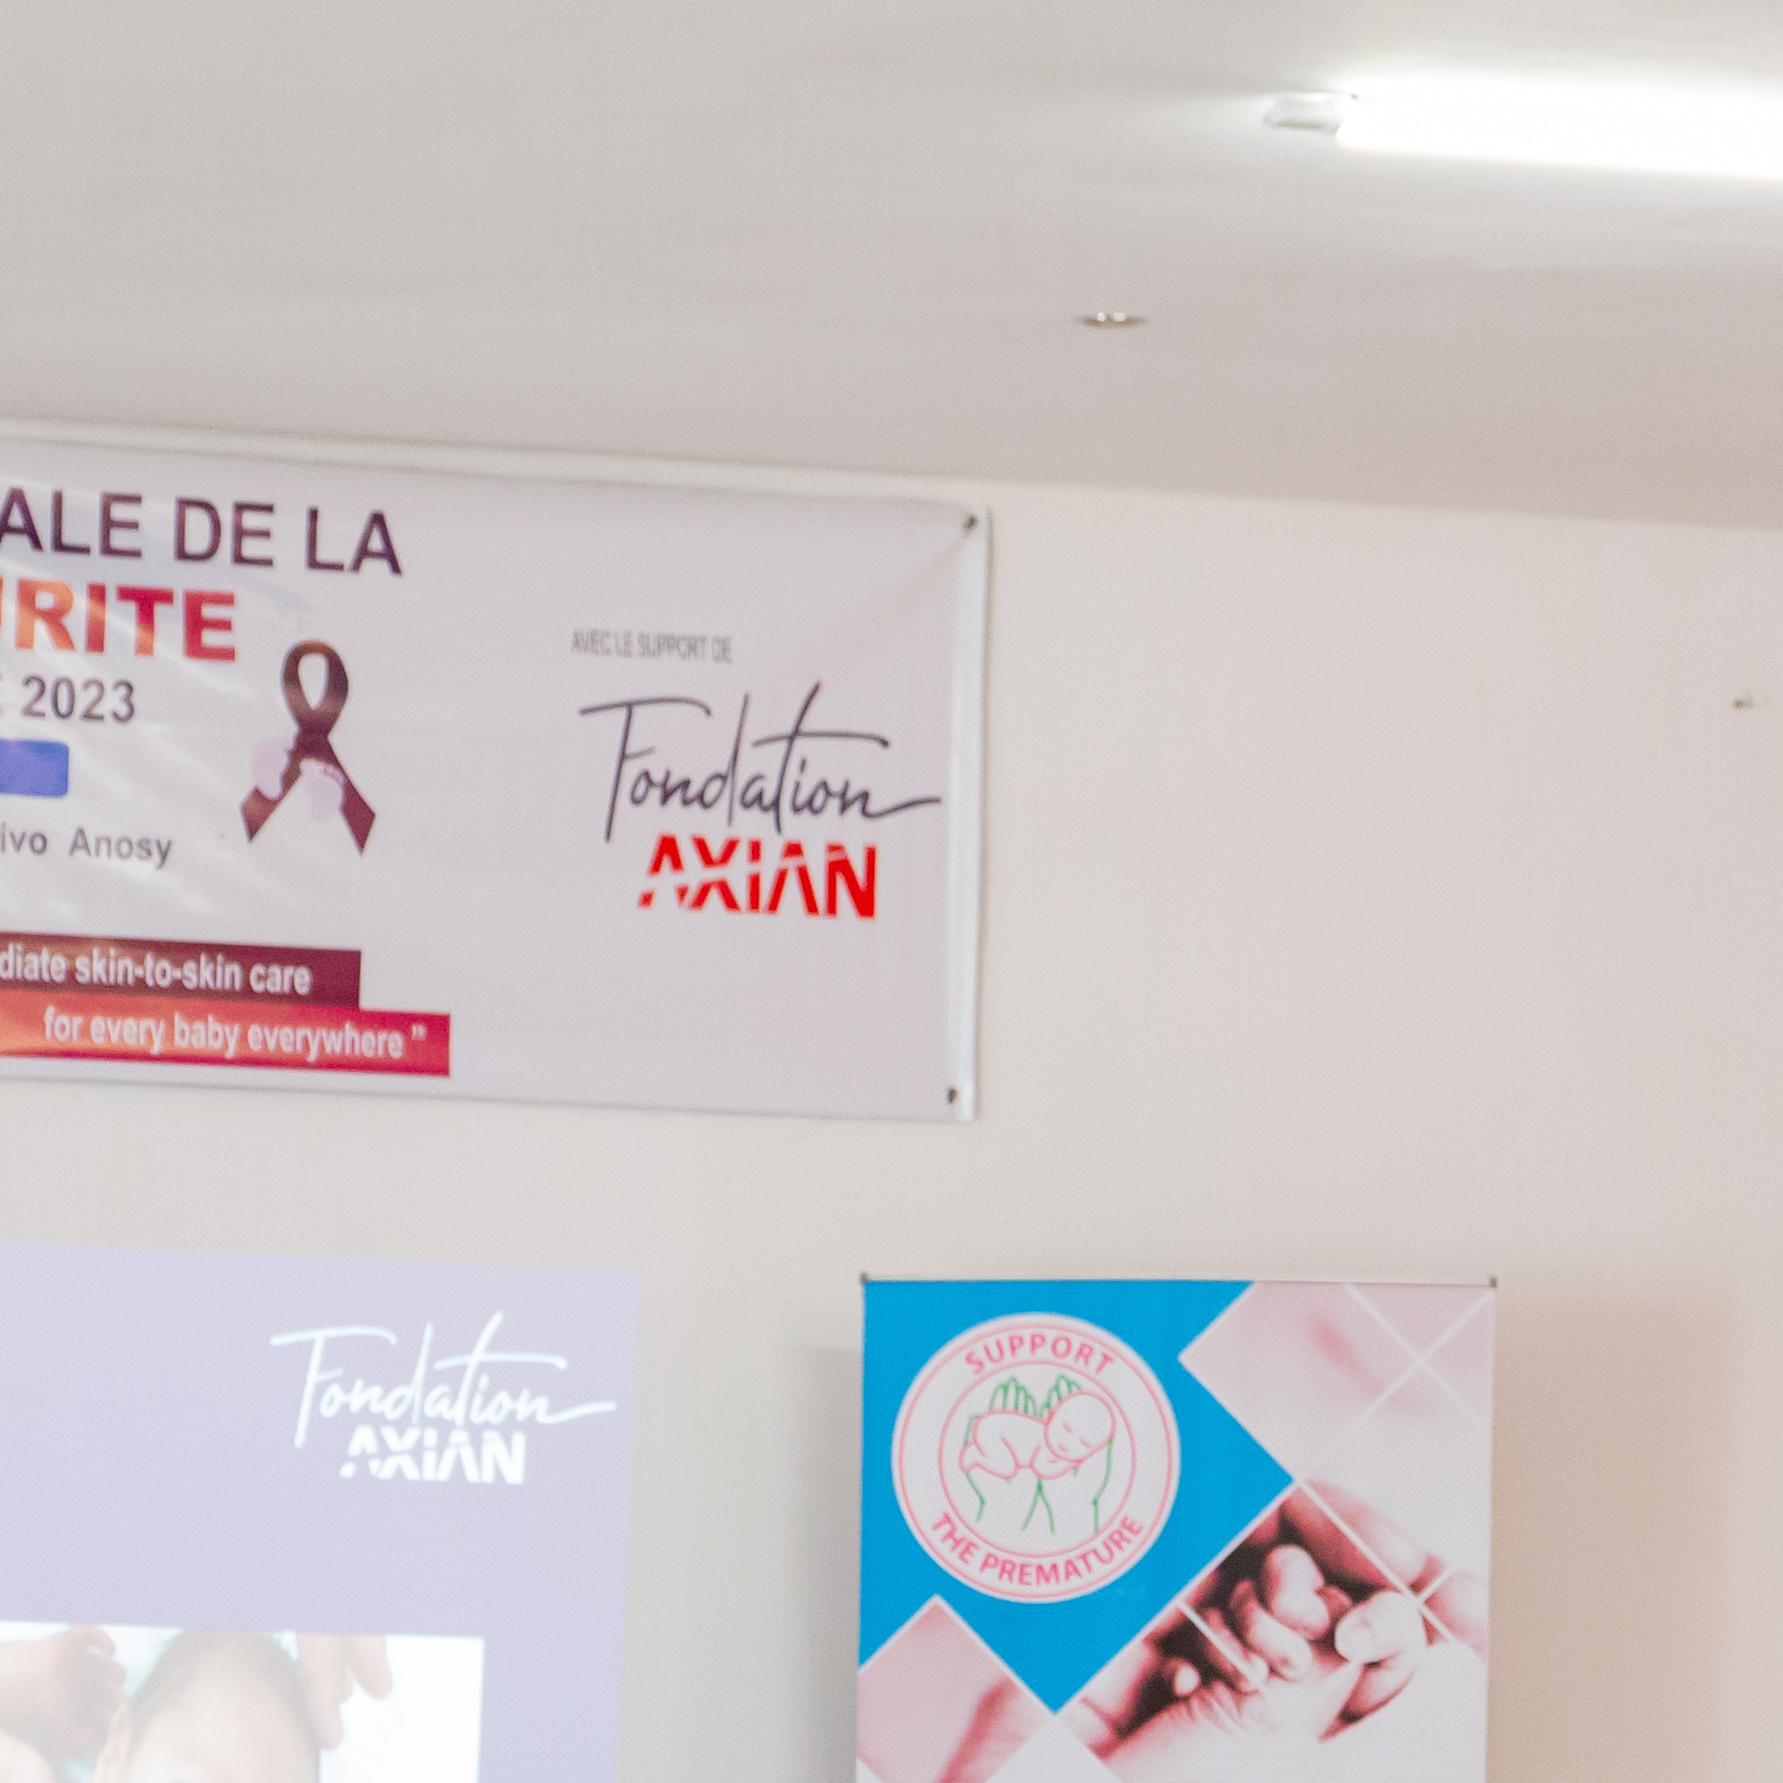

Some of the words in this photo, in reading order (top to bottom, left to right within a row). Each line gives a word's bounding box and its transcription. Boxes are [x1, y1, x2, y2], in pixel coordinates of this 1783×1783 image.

[173, 496, 275, 568] DE
[305, 506, 404, 577] LA
[572, 628, 610, 656] AVEC
[21, 674, 137, 724] 2023
[579, 680, 941, 843] Fondation
[68, 827, 174, 868] Anosy
[637, 832, 877, 920] AXIAN
[75, 947, 242, 992] skin-to-skin
[249, 960, 312, 995] care
[43, 1006, 82, 1041] for
[90, 1016, 167, 1055] every
[173, 1012, 241, 1059] baby
[269, 1310, 617, 1449] Fondation
[966, 1334, 1115, 1375] SUPPORT
[339, 1424, 527, 1486] AXIAN
[931, 1512, 983, 1565] THE
[979, 1515, 1144, 1586] PREMATURE
